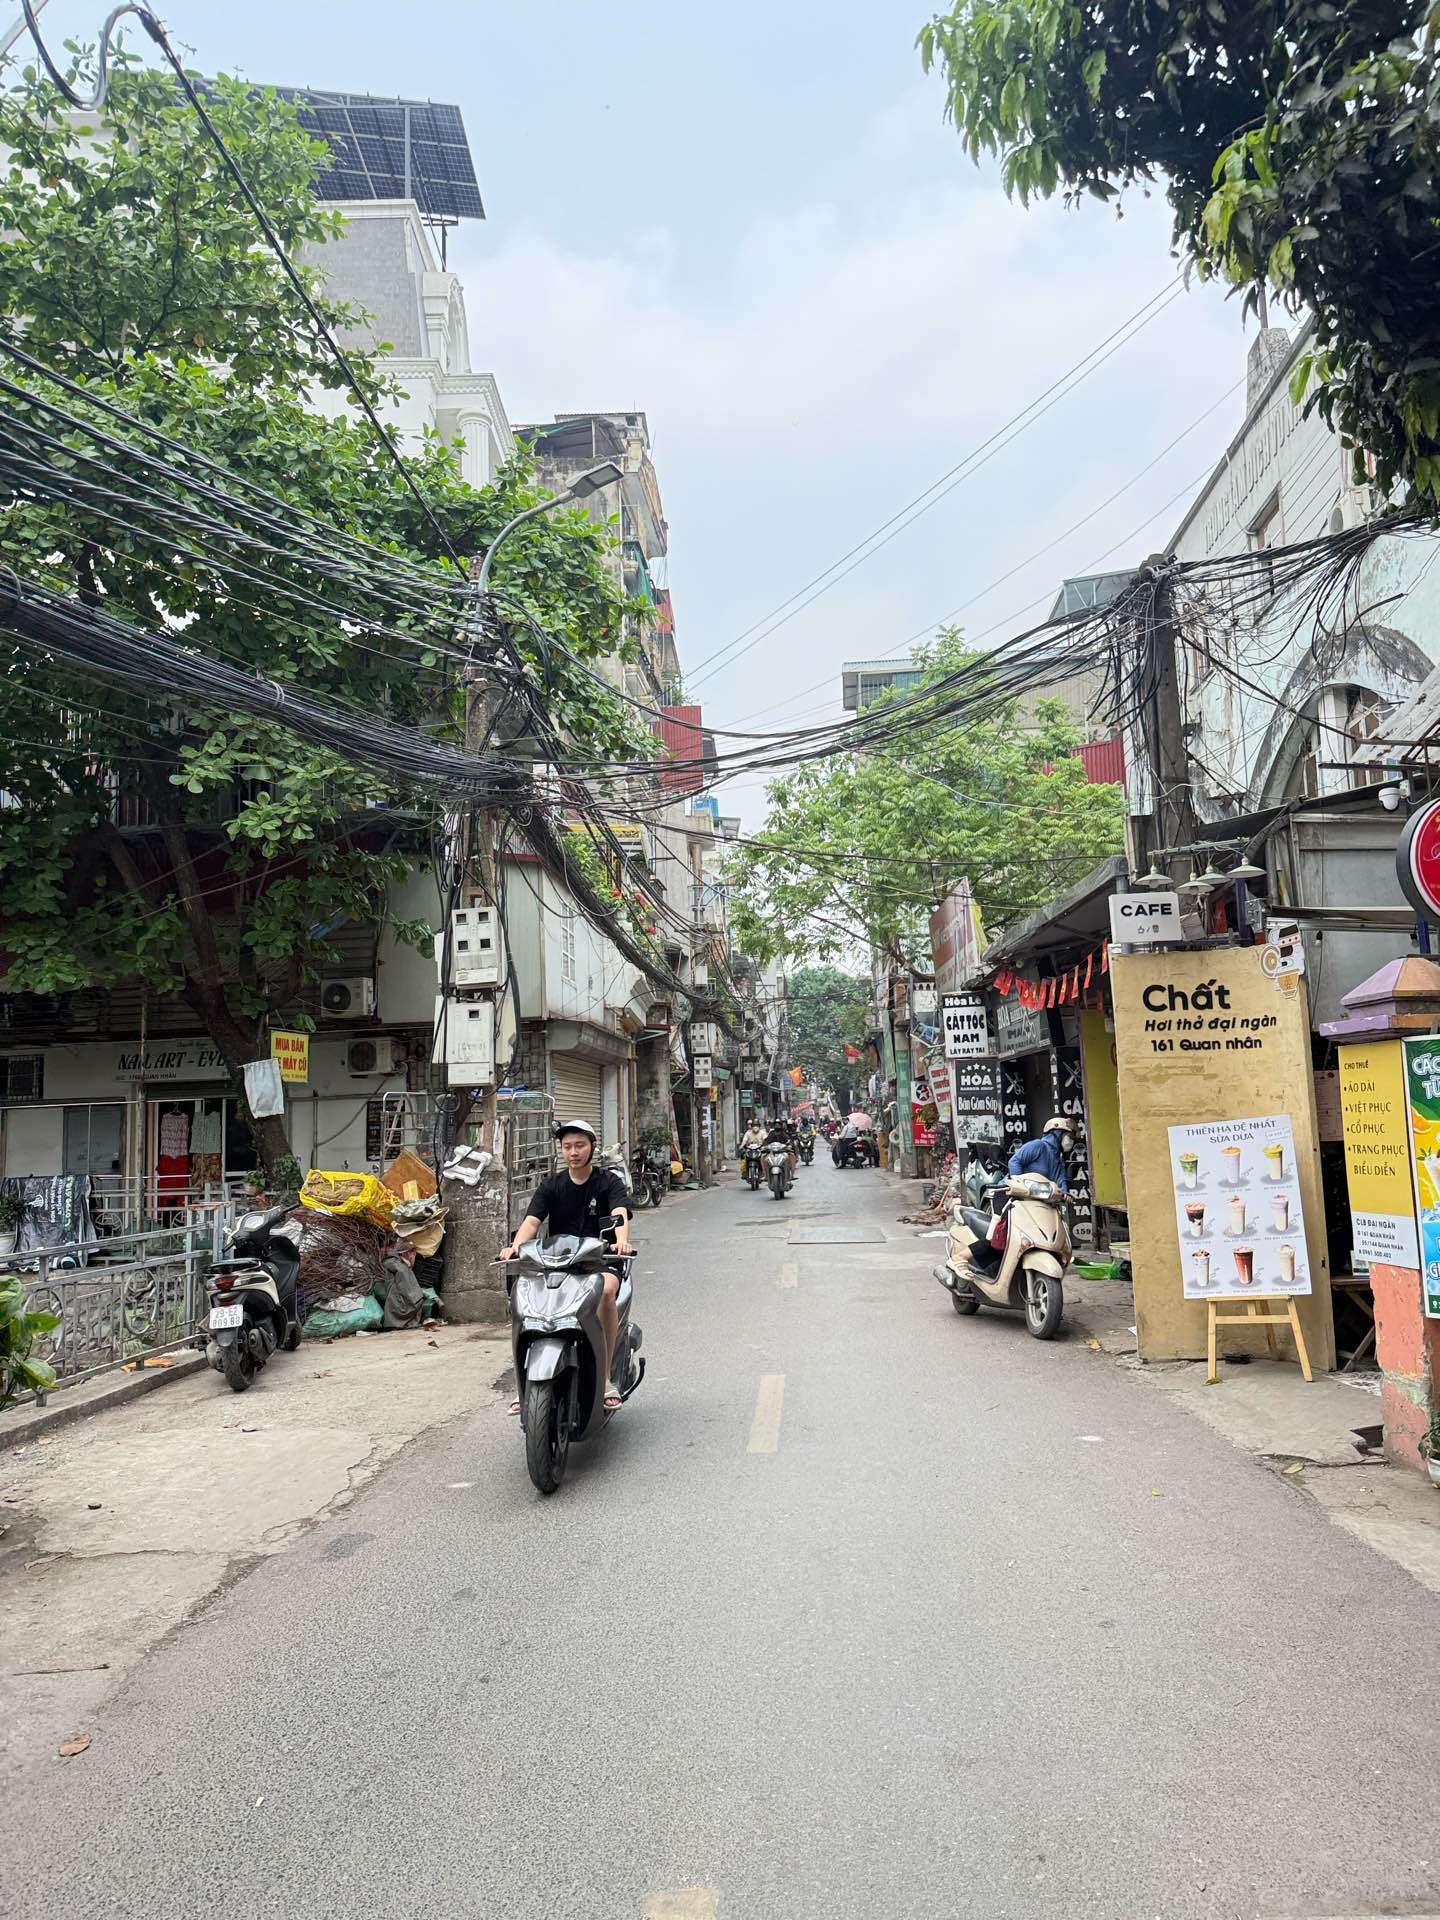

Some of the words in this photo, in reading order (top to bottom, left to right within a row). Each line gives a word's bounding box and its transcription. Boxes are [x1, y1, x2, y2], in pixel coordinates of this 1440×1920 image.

[1120, 903, 1172, 917] CAFE
[1143, 979, 1231, 1012] Chất
[1176, 1015, 1204, 1031] thở
[1208, 1017, 1236, 1032] đại
[1240, 1014, 1277, 1031] ngàn
[275, 1037, 290, 1051] MUA
[291, 1037, 305, 1053] BÁN
[953, 1033, 980, 1043] NAM
[1151, 1039, 1174, 1051] 161
[1179, 1038, 1221, 1051] Quan
[1226, 1036, 1262, 1050] nhân
[154, 1051, 187, 1069] ART
[960, 1072, 993, 1086] HÒA
[1347, 1080, 1359, 1092] ÁO
[1360, 1080, 1375, 1092] DÀI
[1349, 1101, 1367, 1115] VIỆT
[1369, 1101, 1392, 1115] PHỤC
[1350, 1119, 1362, 1134] CỔ
[1363, 1123, 1385, 1135] PHỤC
[1352, 1144, 1380, 1155] TRANG
[1381, 1144, 1405, 1157] PHỤC
[1353, 1160, 1373, 1176] BIỂU
